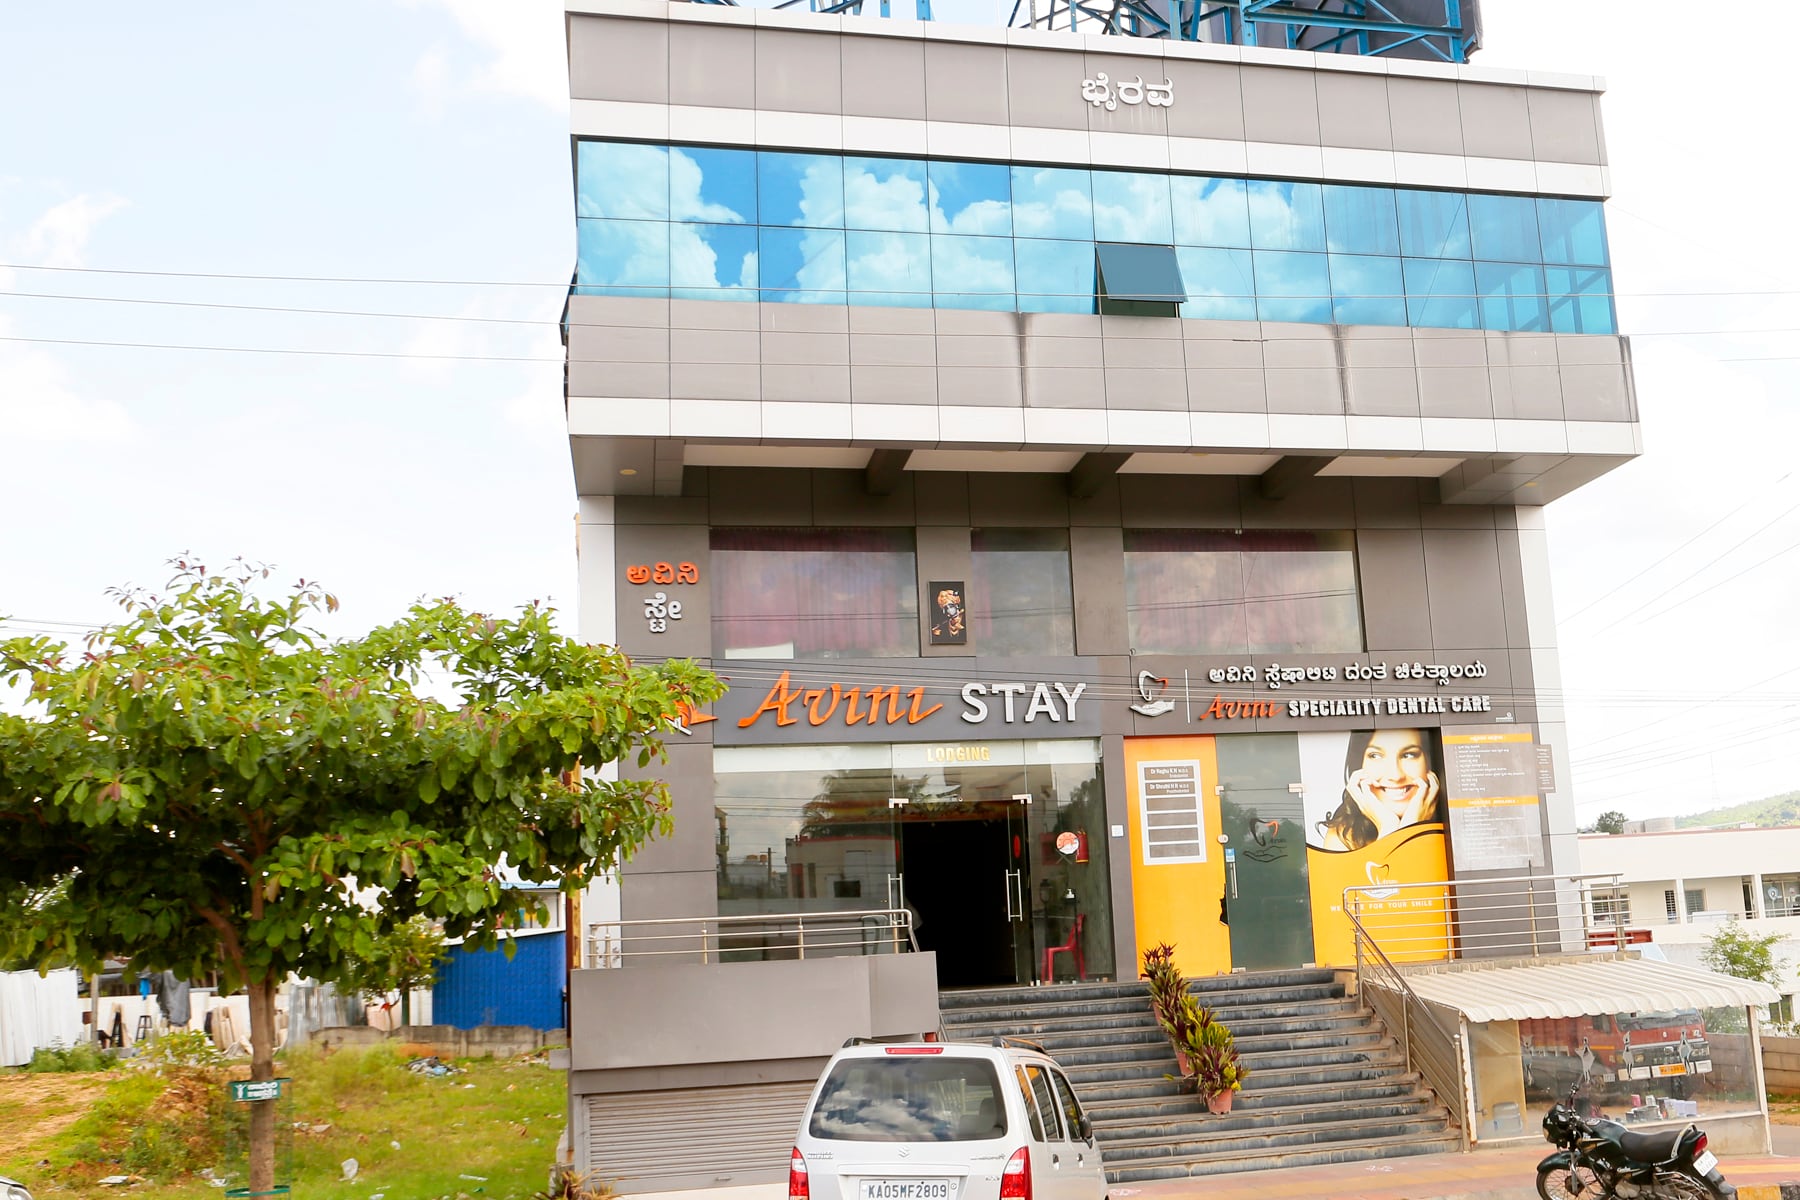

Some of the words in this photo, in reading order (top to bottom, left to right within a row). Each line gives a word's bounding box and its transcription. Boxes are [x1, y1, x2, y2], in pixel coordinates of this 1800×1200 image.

[1081, 71, 1175, 111] ಭೈರವ
[626, 561, 700, 584] ಅವಿನಿ
[644, 592, 682, 633] ಸ್ಟೇ
[1209, 665, 1257, 682] ಅವಿನಿ
[1344, 661, 1388, 680] ದಂತ
[737, 670, 944, 728] Avini
[960, 682, 1087, 724] STAY
[1199, 694, 1284, 720] Avini
[1288, 698, 1381, 717] SPECIALITY
[1387, 697, 1446, 714] DENTAL
[1451, 695, 1492, 713] CARE
[927, 746, 991, 762] LODGING
[868, 1184, 947, 1198] KA05MF2809
